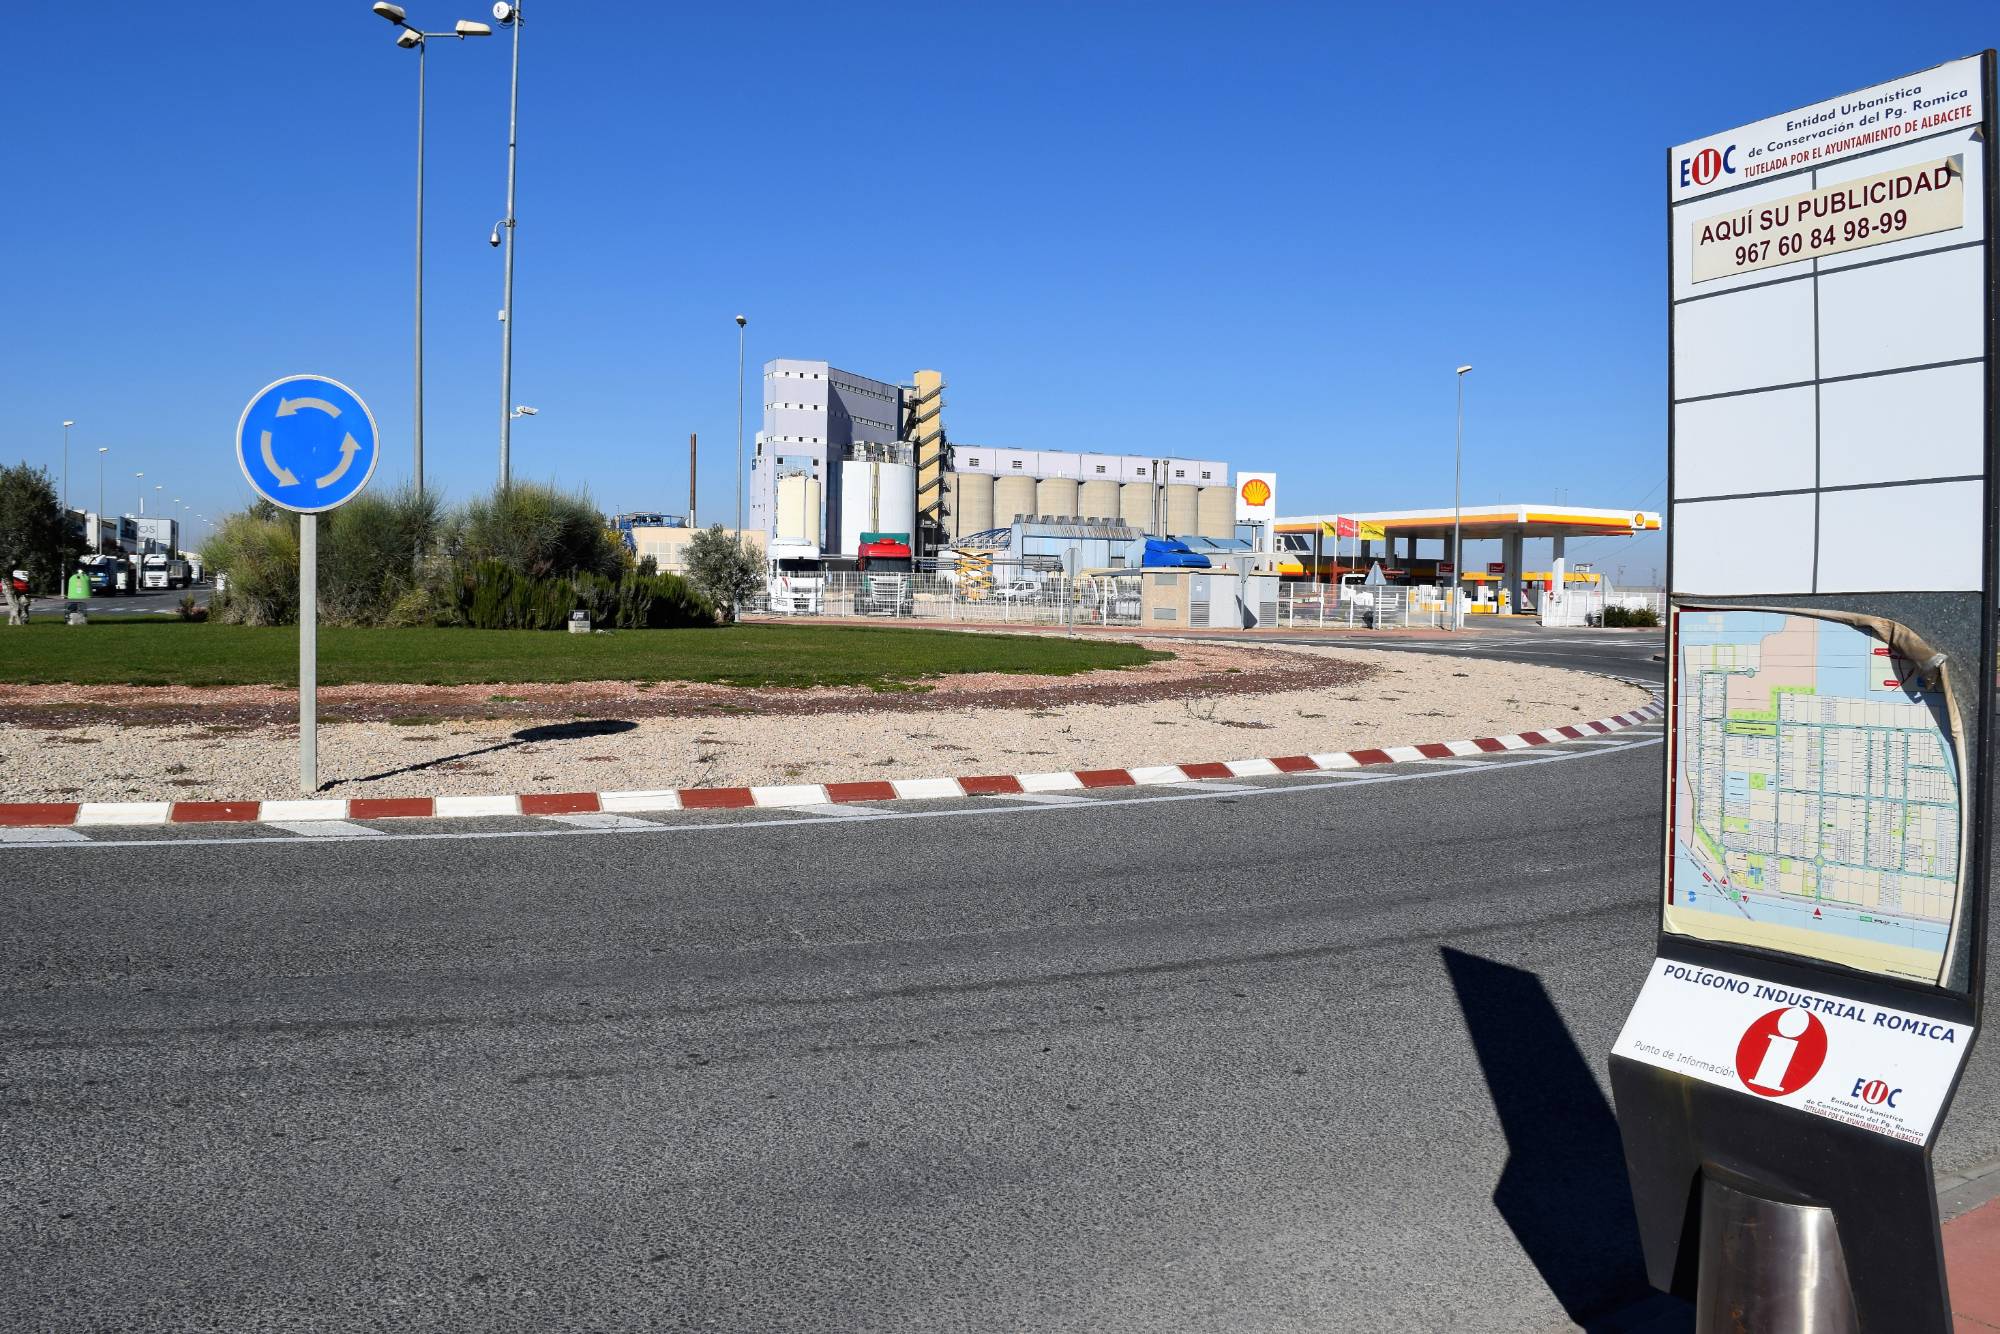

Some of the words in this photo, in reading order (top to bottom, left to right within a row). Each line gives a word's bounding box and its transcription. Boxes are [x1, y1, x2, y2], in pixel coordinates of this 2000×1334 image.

[1748, 147, 1763, 158] de
[1767, 122, 1854, 152] Conservación
[1859, 111, 1880, 127] del
[1885, 108, 1908, 119] Pg.
[1913, 89, 1968, 111] Romica
[1786, 108, 1836, 132] Entidad
[1841, 84, 1922, 116] Urbanística
[1745, 157, 1788, 178] TUTELADA
[1790, 150, 1810, 165] POR
[1812, 147, 1822, 159] EL
[1825, 125, 1901, 156] AYUNTAMIENTO
[1904, 119, 1918, 134] DE
[1921, 104, 1972, 130] ALBACETE
[1700, 210, 1753, 246] AQUÍ
[1760, 205, 1789, 231] SU
[1798, 166, 1951, 222] PUBLICIDAD
[1735, 240, 1771, 266] 967
[1778, 233, 1803, 257] 60
[1811, 225, 1837, 249] 84
[1844, 209, 1908, 242] 98-99
[1664, 965, 1749, 994] POLÍGONO
[1753, 985, 1866, 1023] INDUSTRIAL
[1872, 1012, 1955, 1043] ROMICA
[1634, 1040, 1660, 1056] Punto
[1662, 1049, 1675, 1060] de
[1677, 1053, 1735, 1078] Información
[1803, 1104, 1828, 1117] TUTELADA
[1846, 1116, 1887, 1134] AYUNTAMIENTO
[1896, 1131, 1921, 1145] ALBACETE
[1830, 1096, 1859, 1110] Entidad
